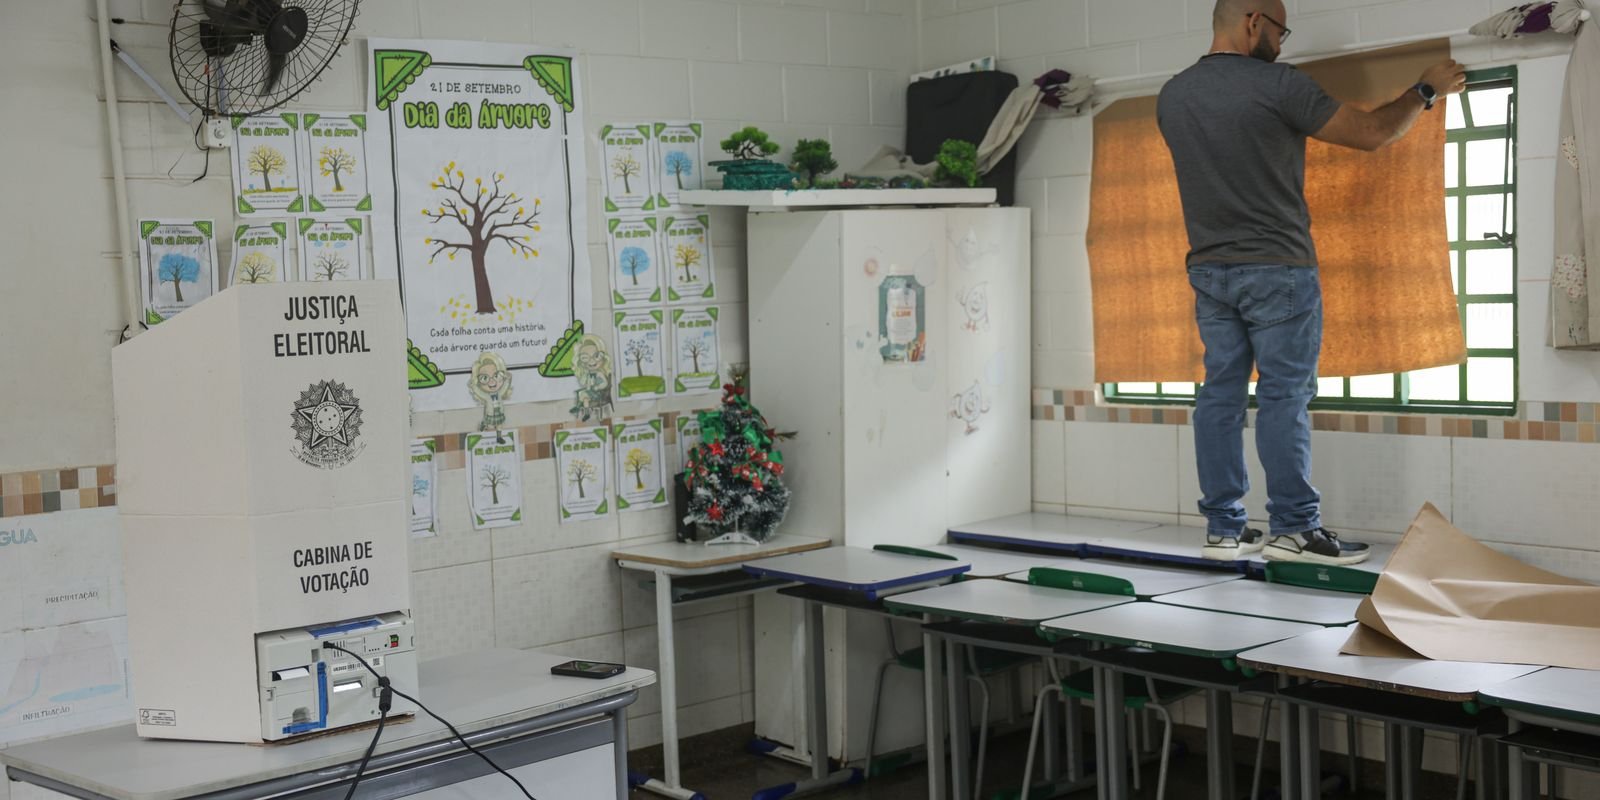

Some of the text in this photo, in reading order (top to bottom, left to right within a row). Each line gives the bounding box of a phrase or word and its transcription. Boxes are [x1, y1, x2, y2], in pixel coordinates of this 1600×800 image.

[430, 82, 522, 94] 21 DE SETEMBRO
[403, 98, 551, 129] Dia da Árvore
[284, 295, 359, 325] JUSTIÇA
[430, 328, 450, 338] Cada
[451, 326, 472, 336] folha
[474, 327, 496, 336] conta
[497, 326, 514, 334] uma
[274, 330, 371, 357] ELEITORAL
[430, 338, 547, 353] cada árvore guarda um futuro!
[293, 541, 373, 568] CABINA DE
[300, 566, 369, 593] VOTAÇÃO
[46, 591, 98, 604] PRECIPITAÇÃO
[22, 706, 70, 721] INFILTRAÇÃO
